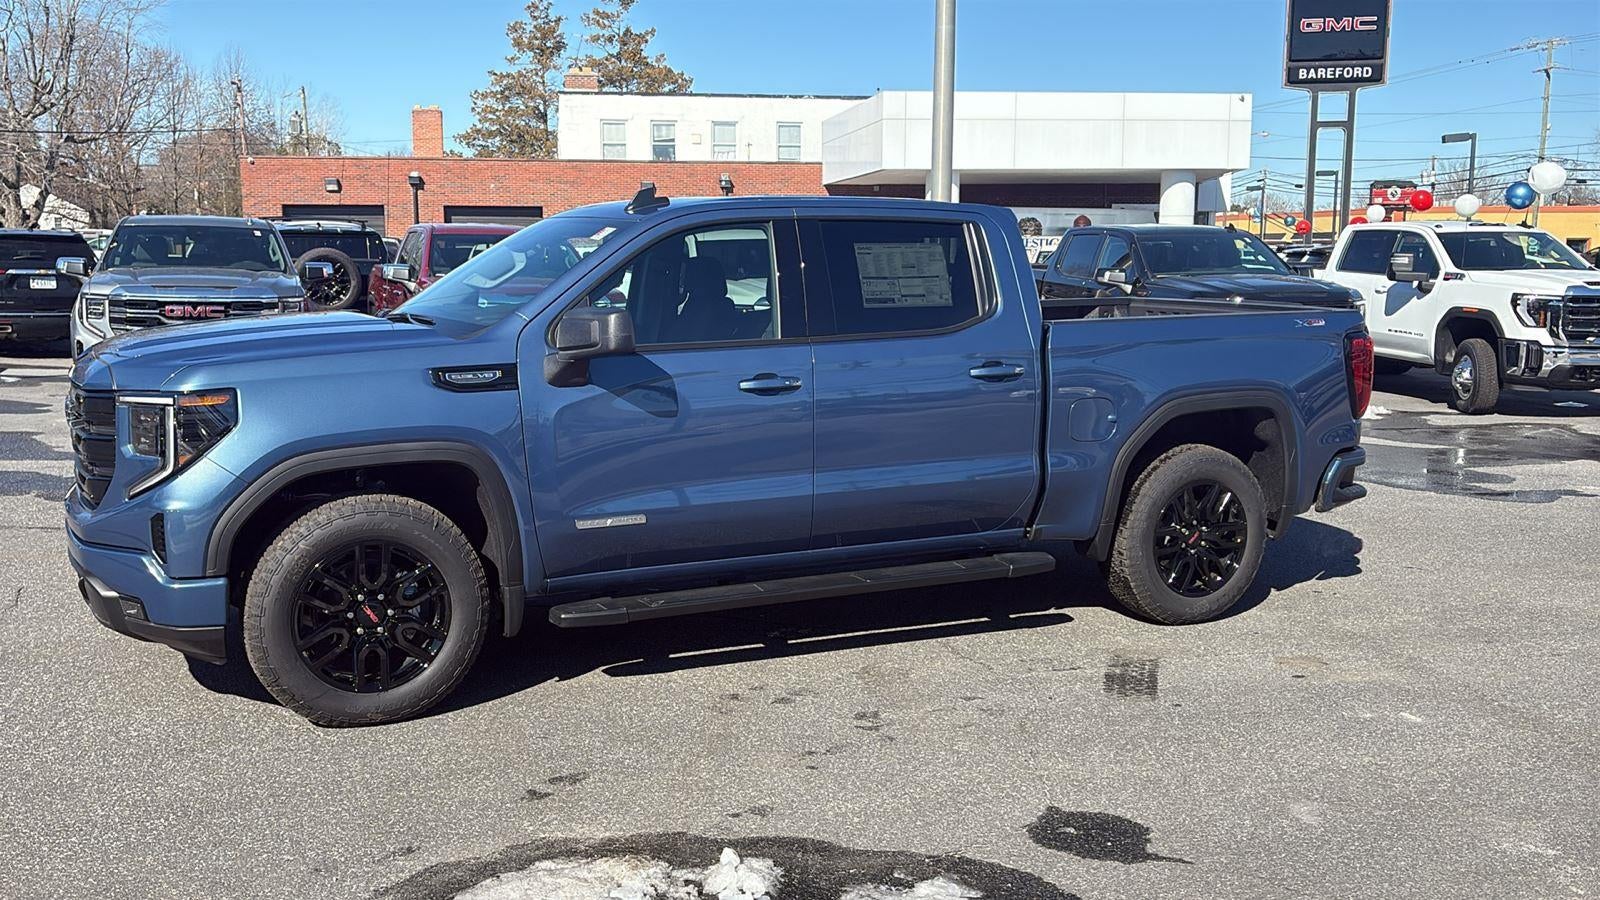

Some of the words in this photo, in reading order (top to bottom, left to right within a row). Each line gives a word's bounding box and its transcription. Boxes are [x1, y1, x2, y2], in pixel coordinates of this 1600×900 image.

[1300, 16, 1378, 32] GMC
[1298, 66, 1373, 80] BAREFORD
[165, 305, 225, 318] GMC
